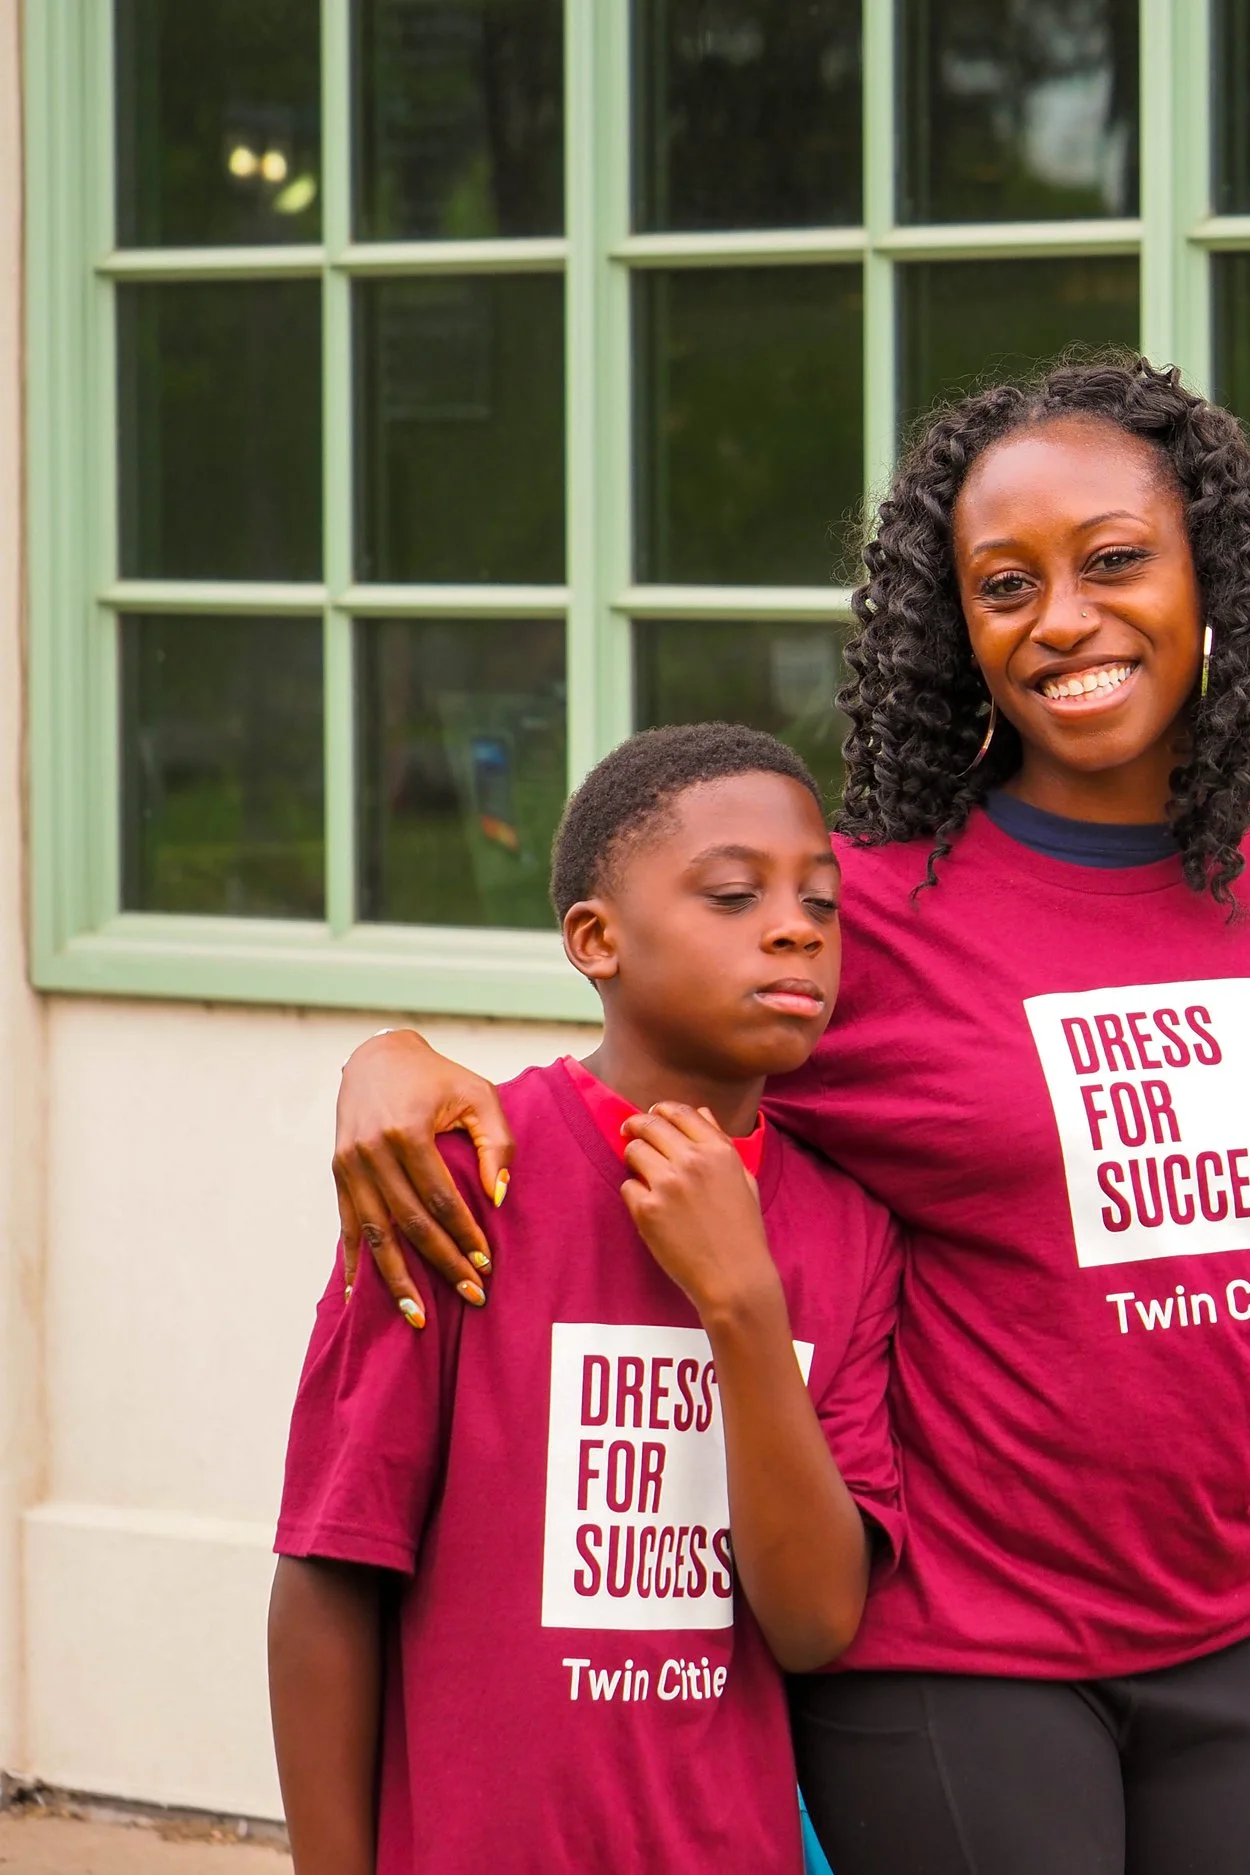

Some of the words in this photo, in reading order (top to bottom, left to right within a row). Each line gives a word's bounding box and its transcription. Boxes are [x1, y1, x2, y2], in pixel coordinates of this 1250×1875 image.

[1060, 1005, 1223, 1075] DRESS
[1080, 1079, 1182, 1151] FOR
[1105, 1285, 1218, 1334] Twin
[581, 1354, 718, 1432] DRESS
[577, 1439, 666, 1513] FOR
[574, 1524, 734, 1599] SUCCESS
[562, 1657, 649, 1702] Twin
[656, 1656, 728, 1700] Citie
